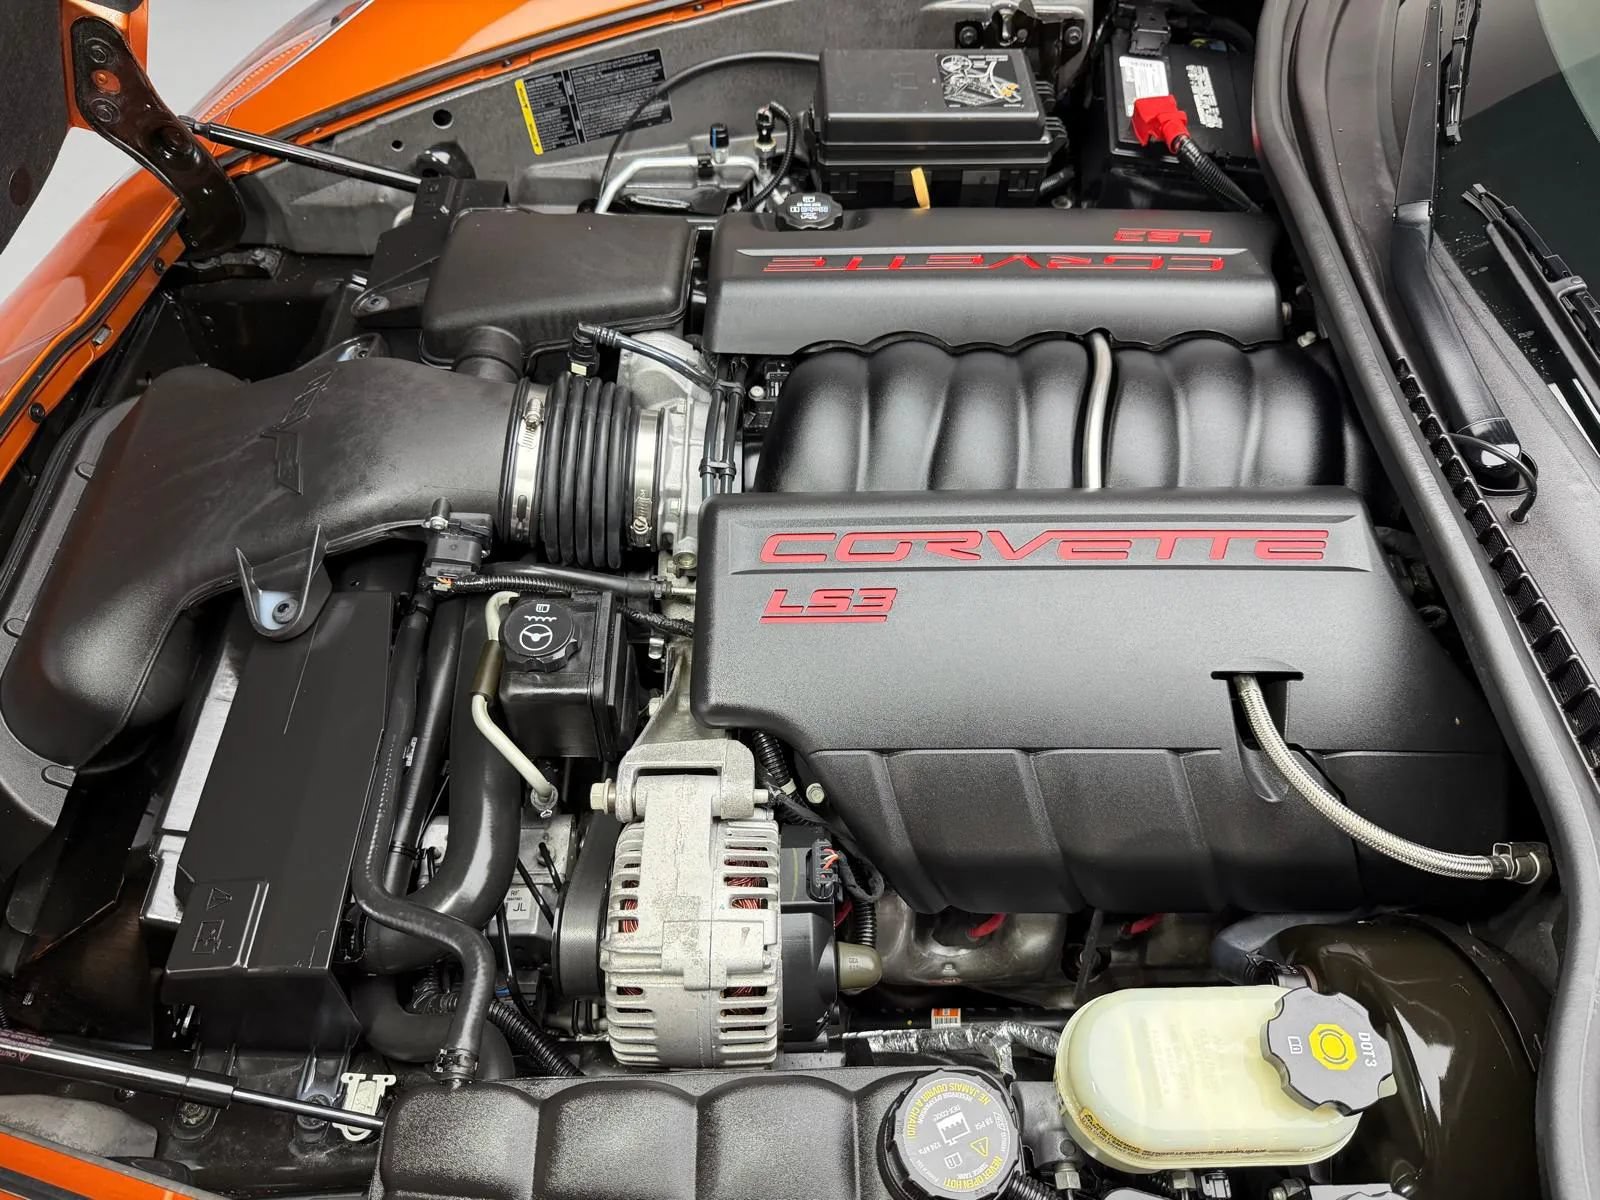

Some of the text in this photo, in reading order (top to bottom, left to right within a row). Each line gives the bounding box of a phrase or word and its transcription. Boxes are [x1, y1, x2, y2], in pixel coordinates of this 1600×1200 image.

[1113, 227, 1214, 243] LS3
[762, 254, 1225, 272] CORVETTE
[760, 530, 1329, 564] CORVETTE
[763, 588, 898, 614] LS3
[513, 902, 526, 911] JL
[1358, 1032, 1377, 1067] DOT 3
[923, 1083, 948, 1102] OUVRIR
[949, 1082, 980, 1096] JAMAIS
[978, 1095, 992, 1105] NE
[944, 1155, 1003, 1190] NEVER OPEN HOT!
